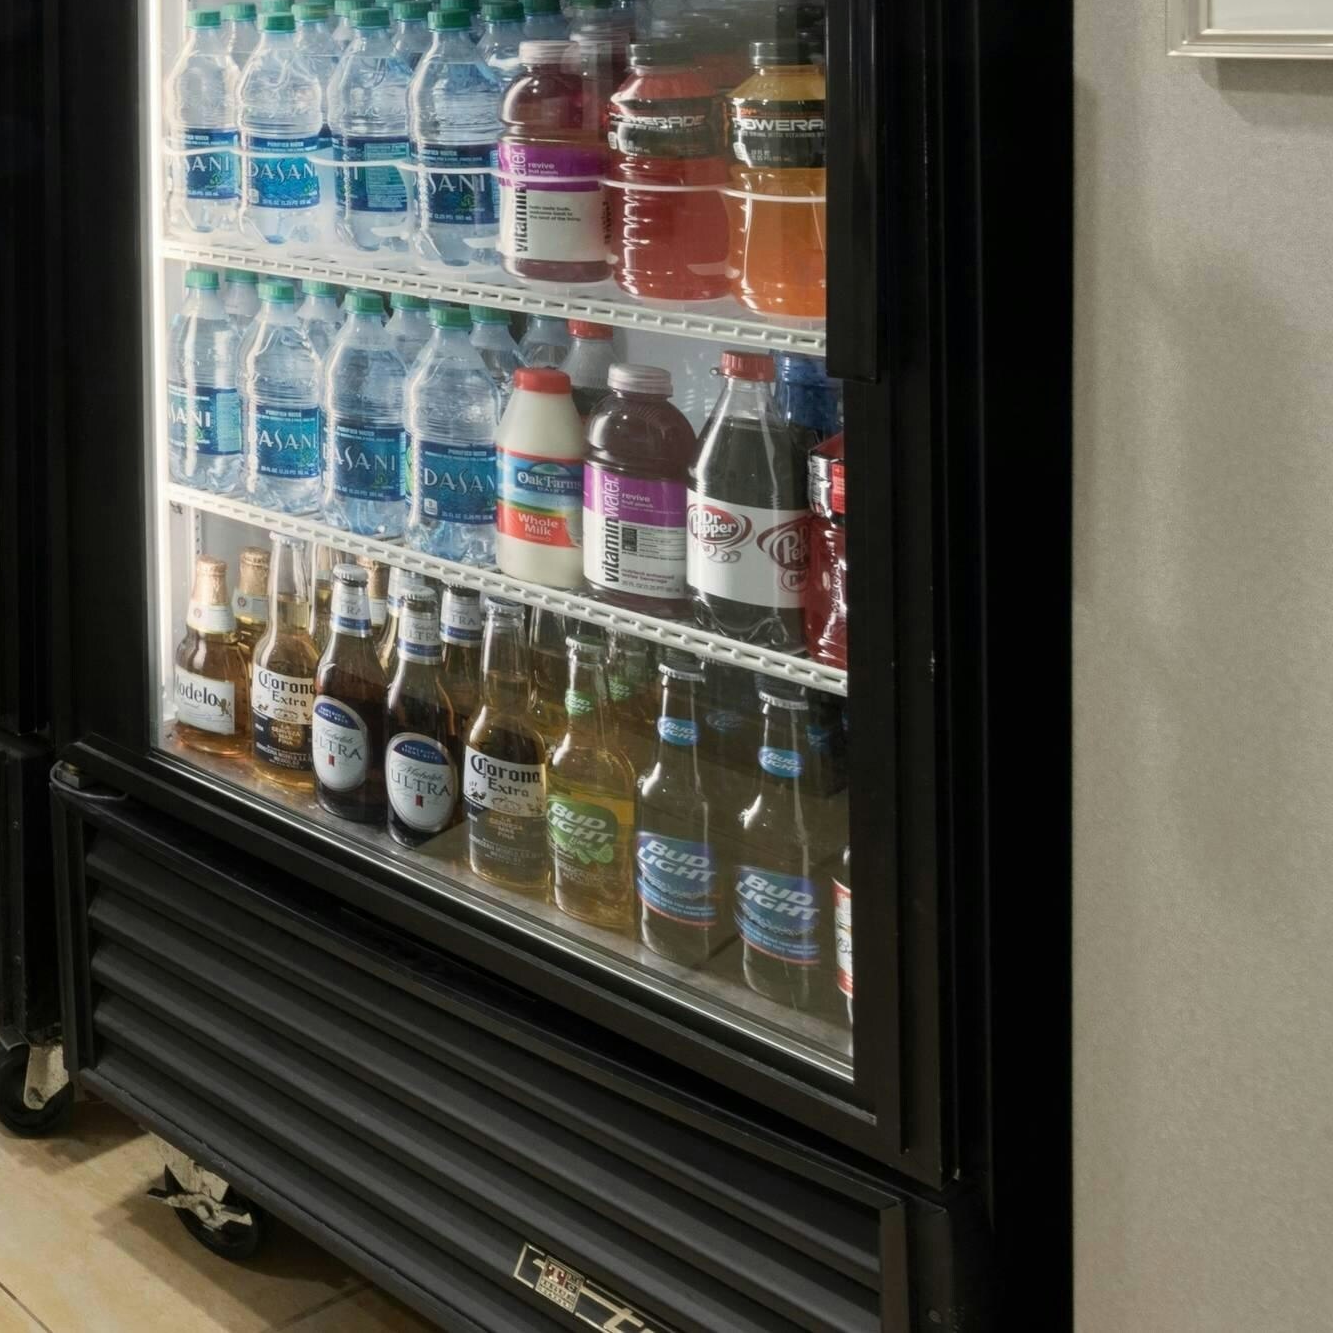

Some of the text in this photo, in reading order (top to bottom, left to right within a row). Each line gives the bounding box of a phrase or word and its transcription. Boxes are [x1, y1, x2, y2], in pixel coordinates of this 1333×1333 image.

[517, 470, 543, 487] Oak
[621, 492, 652, 503] revive
[518, 512, 558, 529] Whole
[524, 523, 552, 537] Milk
[272, 690, 307, 708] Extra
[391, 769, 452, 796] ULTRA
[488, 777, 530, 798] Extra
[550, 801, 608, 830] BUD
[638, 846, 717, 883] LIGHT
[645, 839, 710, 868] BUD
[735, 880, 820, 920] LIGHT
[744, 873, 814, 906] BUD
